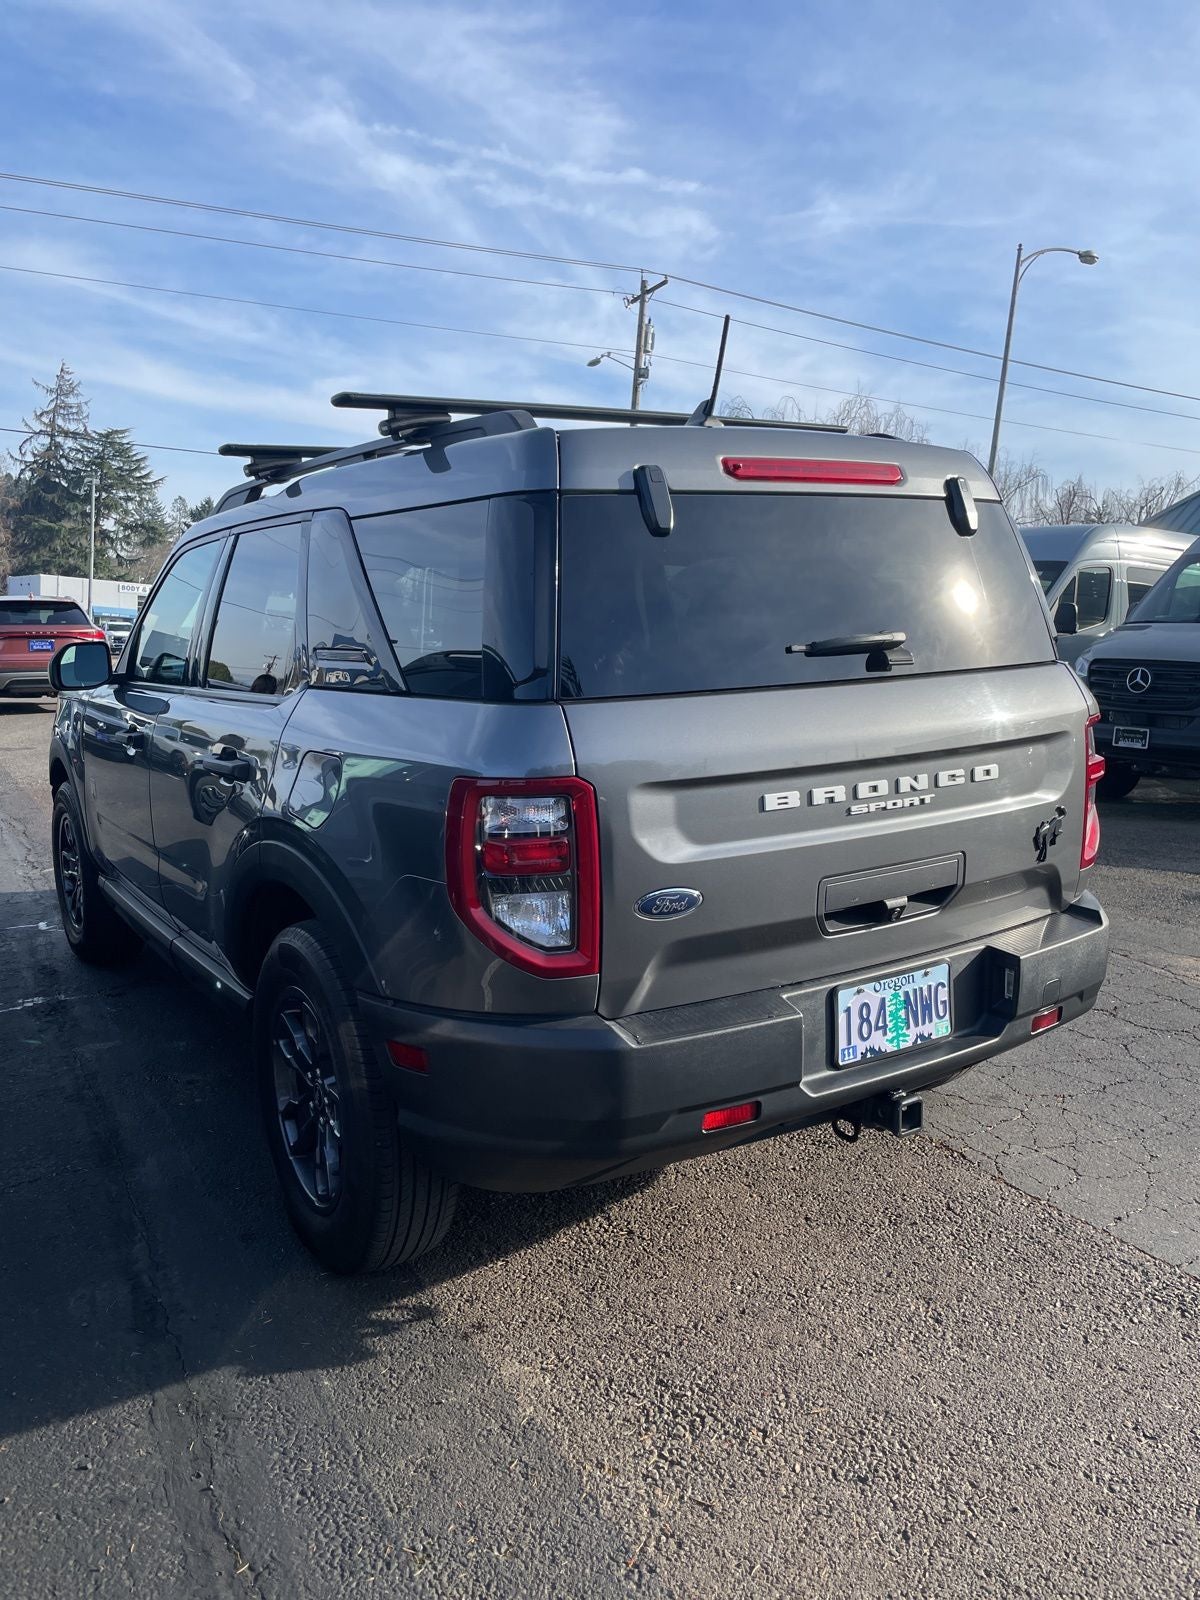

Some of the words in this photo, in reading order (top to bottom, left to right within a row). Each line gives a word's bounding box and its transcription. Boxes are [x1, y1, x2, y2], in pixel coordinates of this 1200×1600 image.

[121, 584, 140, 592] BODY
[761, 763, 1000, 812] BRONCO
[847, 793, 936, 816] SPORT
[651, 894, 689, 914] Ford
[873, 973, 915, 993] Oregon
[843, 996, 889, 1046] 184
[902, 981, 948, 1030] NWG
[843, 1049, 855, 1060] 11
